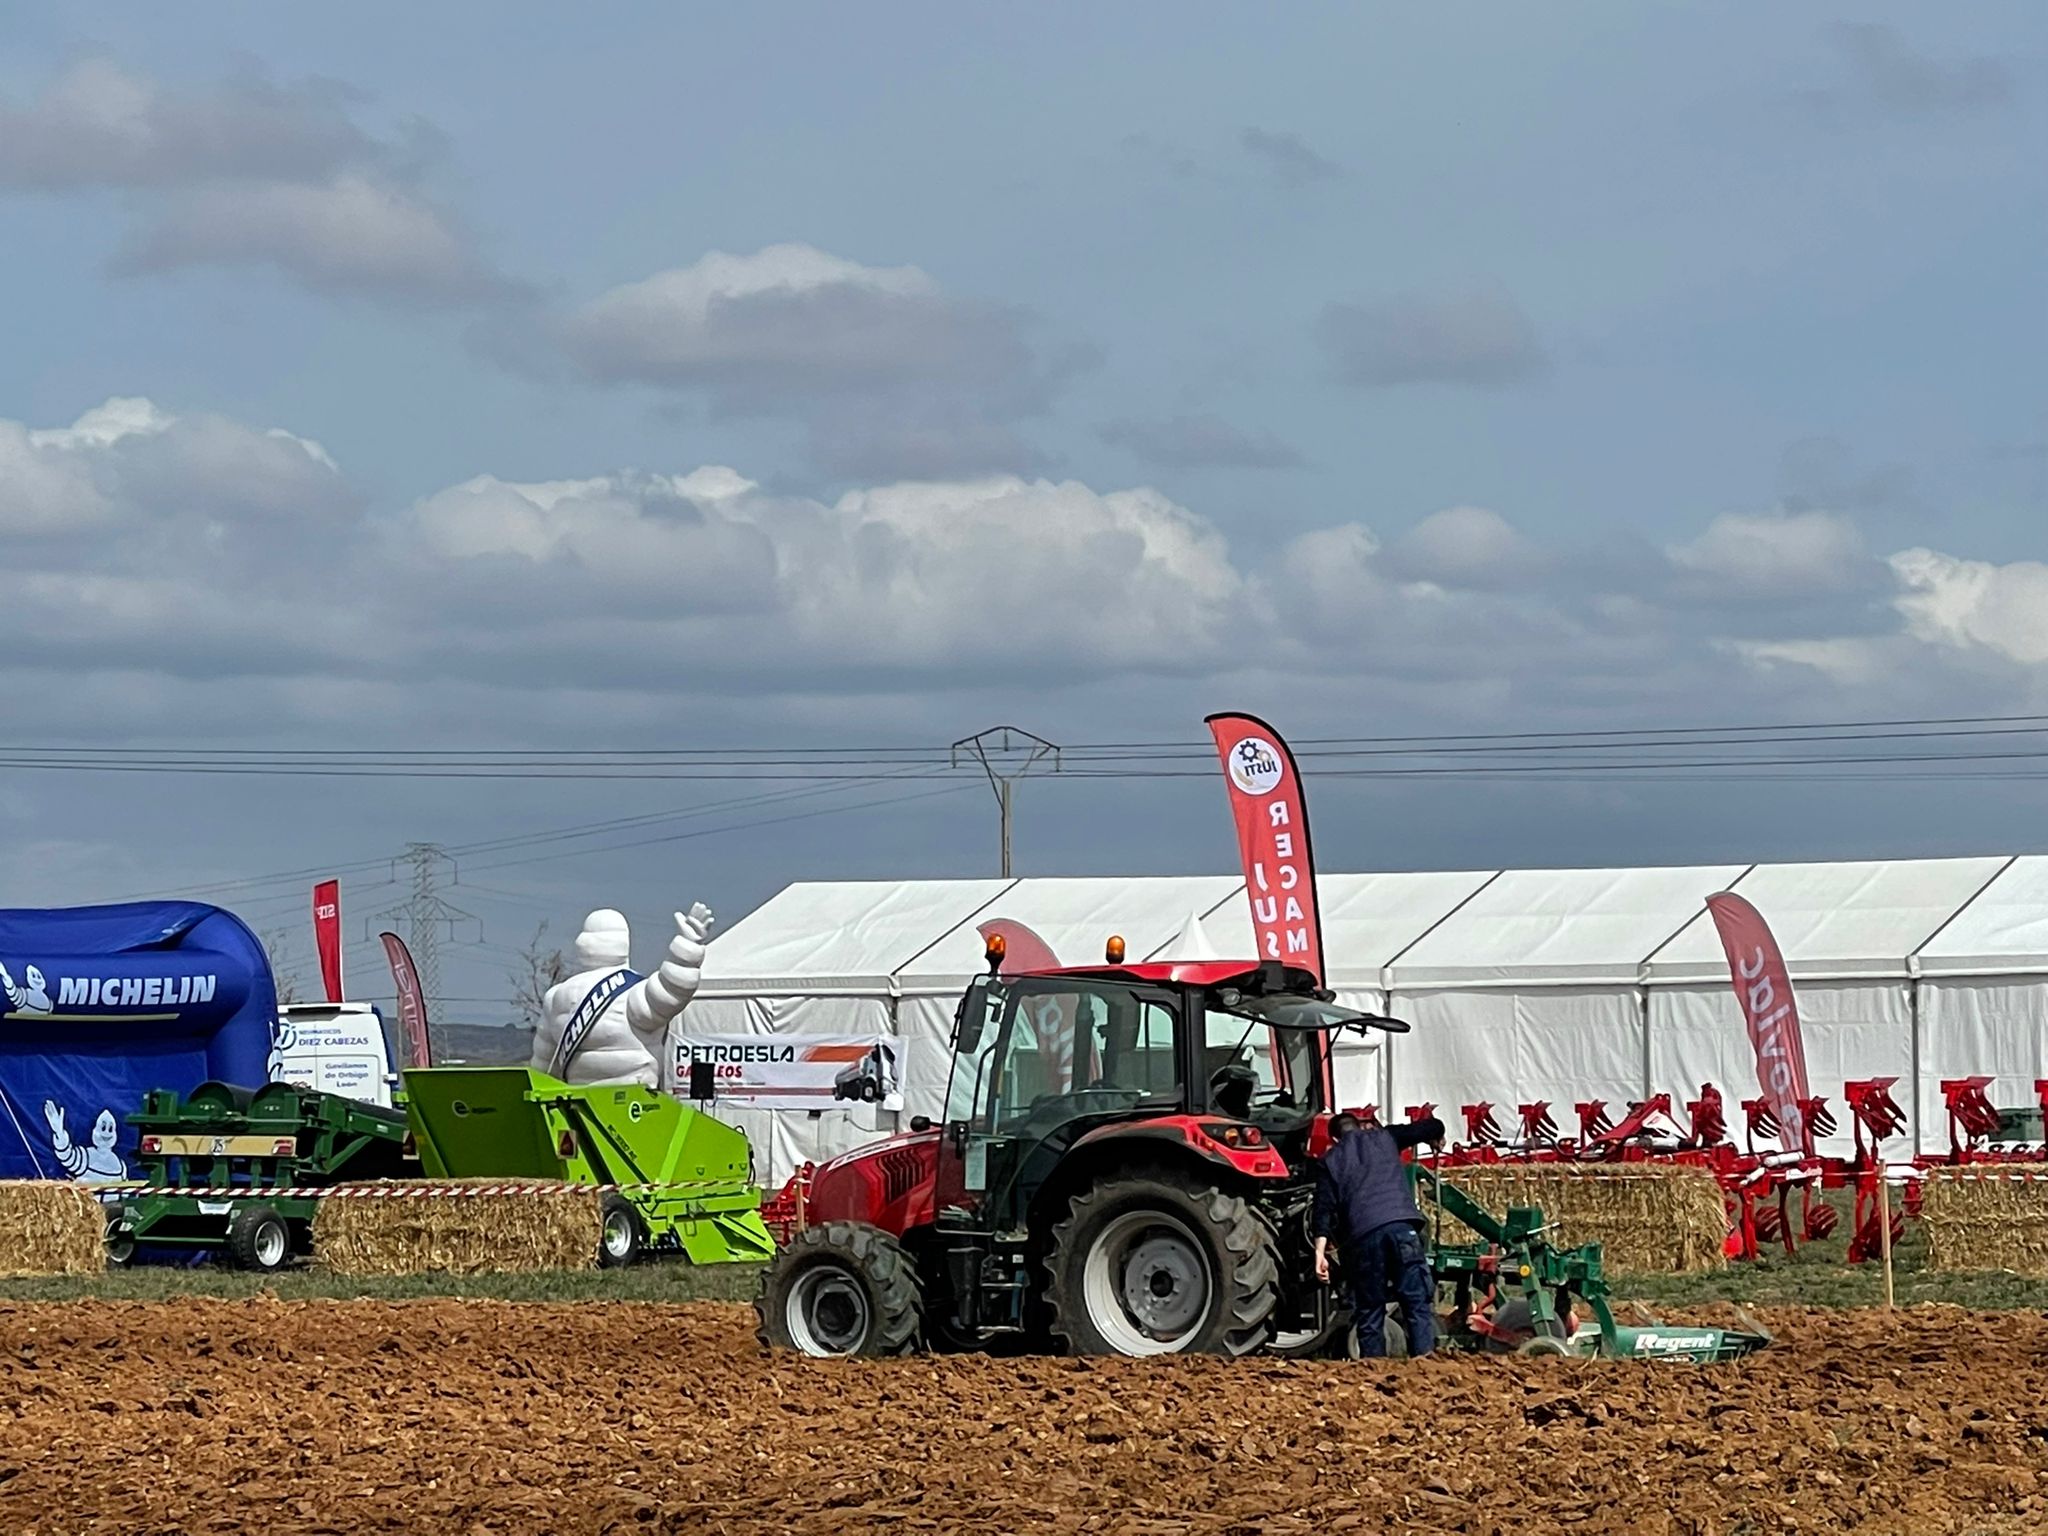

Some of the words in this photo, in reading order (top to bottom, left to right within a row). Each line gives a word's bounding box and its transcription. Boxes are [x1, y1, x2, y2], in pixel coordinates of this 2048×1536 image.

[57, 974, 216, 1006] MICHELIN
[298, 1037, 321, 1046] DIEZ
[324, 1036, 369, 1046] CABEZAS
[676, 1045, 794, 1063] PETROESLA
[676, 1065, 742, 1078] GAEOS
[1635, 1332, 1716, 1353] Regent
